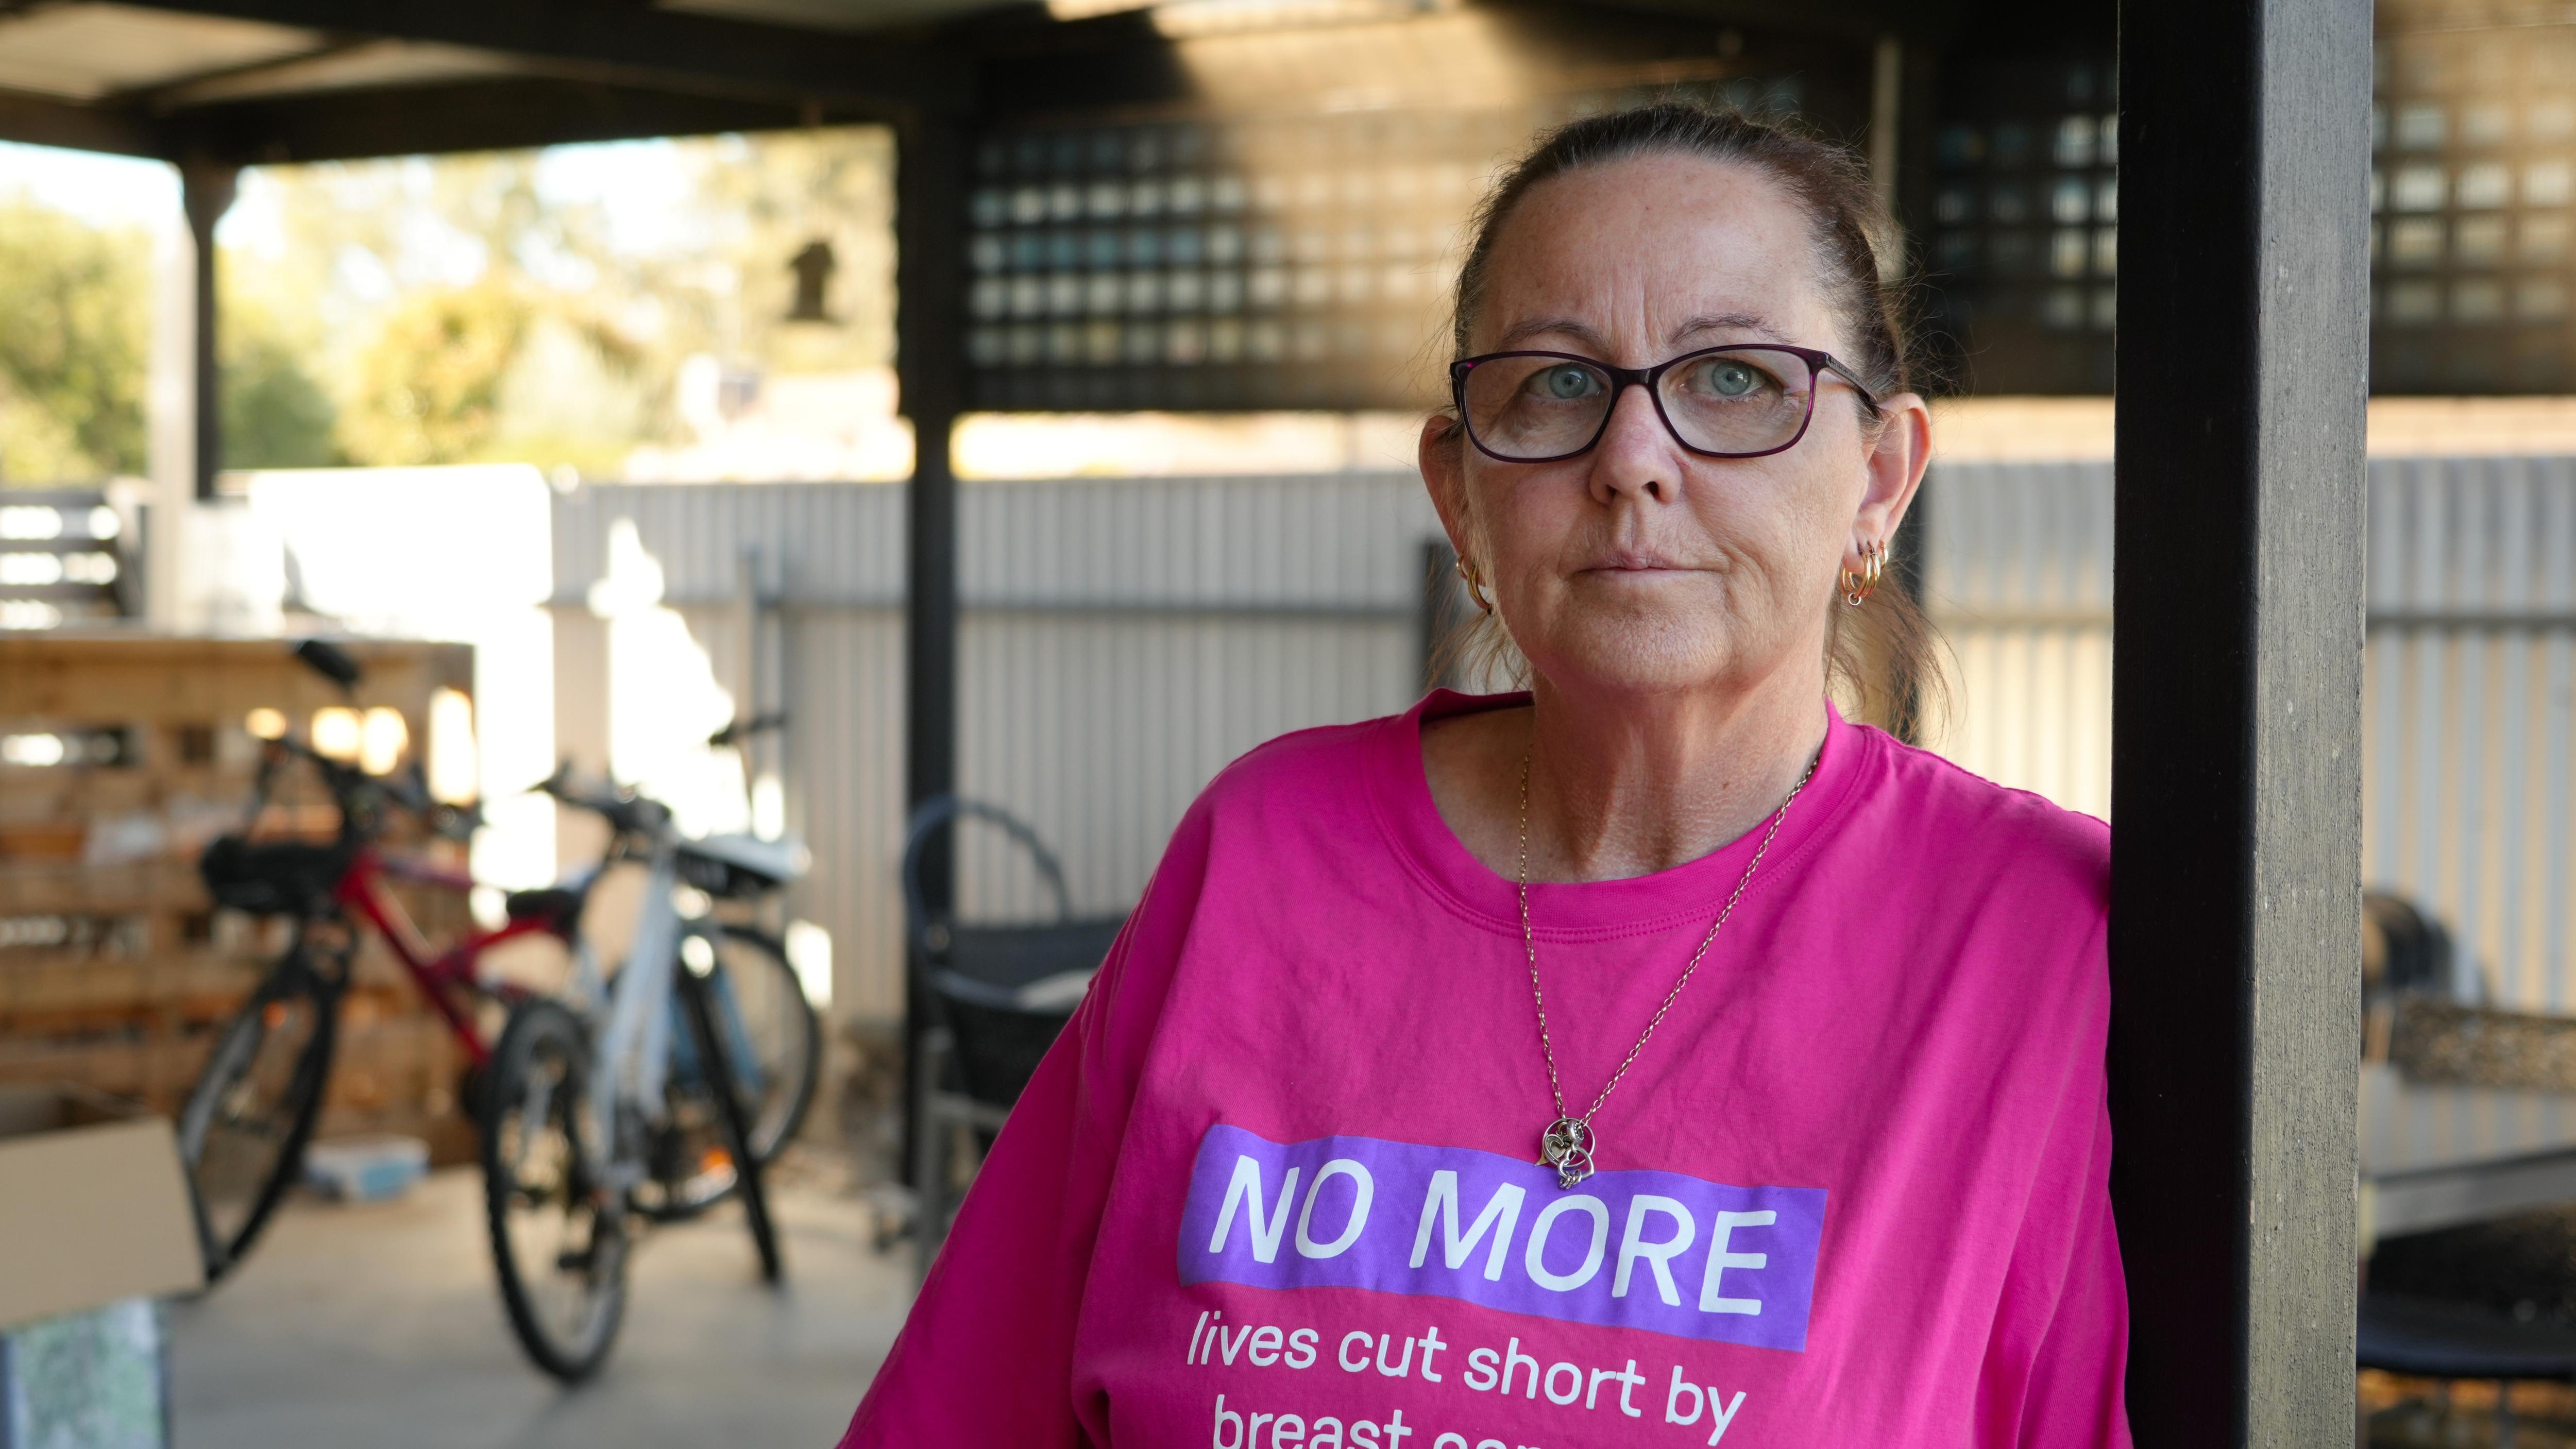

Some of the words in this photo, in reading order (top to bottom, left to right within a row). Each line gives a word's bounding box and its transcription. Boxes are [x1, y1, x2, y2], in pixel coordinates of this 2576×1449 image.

[1208, 1153, 1375, 1264] NO
[1408, 1169, 1778, 1317] MORE
[1187, 1310, 1319, 1369] lives
[1338, 1325, 1448, 1383] cut
[1464, 1336, 1647, 1418] short
[1665, 1365, 1747, 1447] by
[1213, 1393, 1413, 1449] breast
